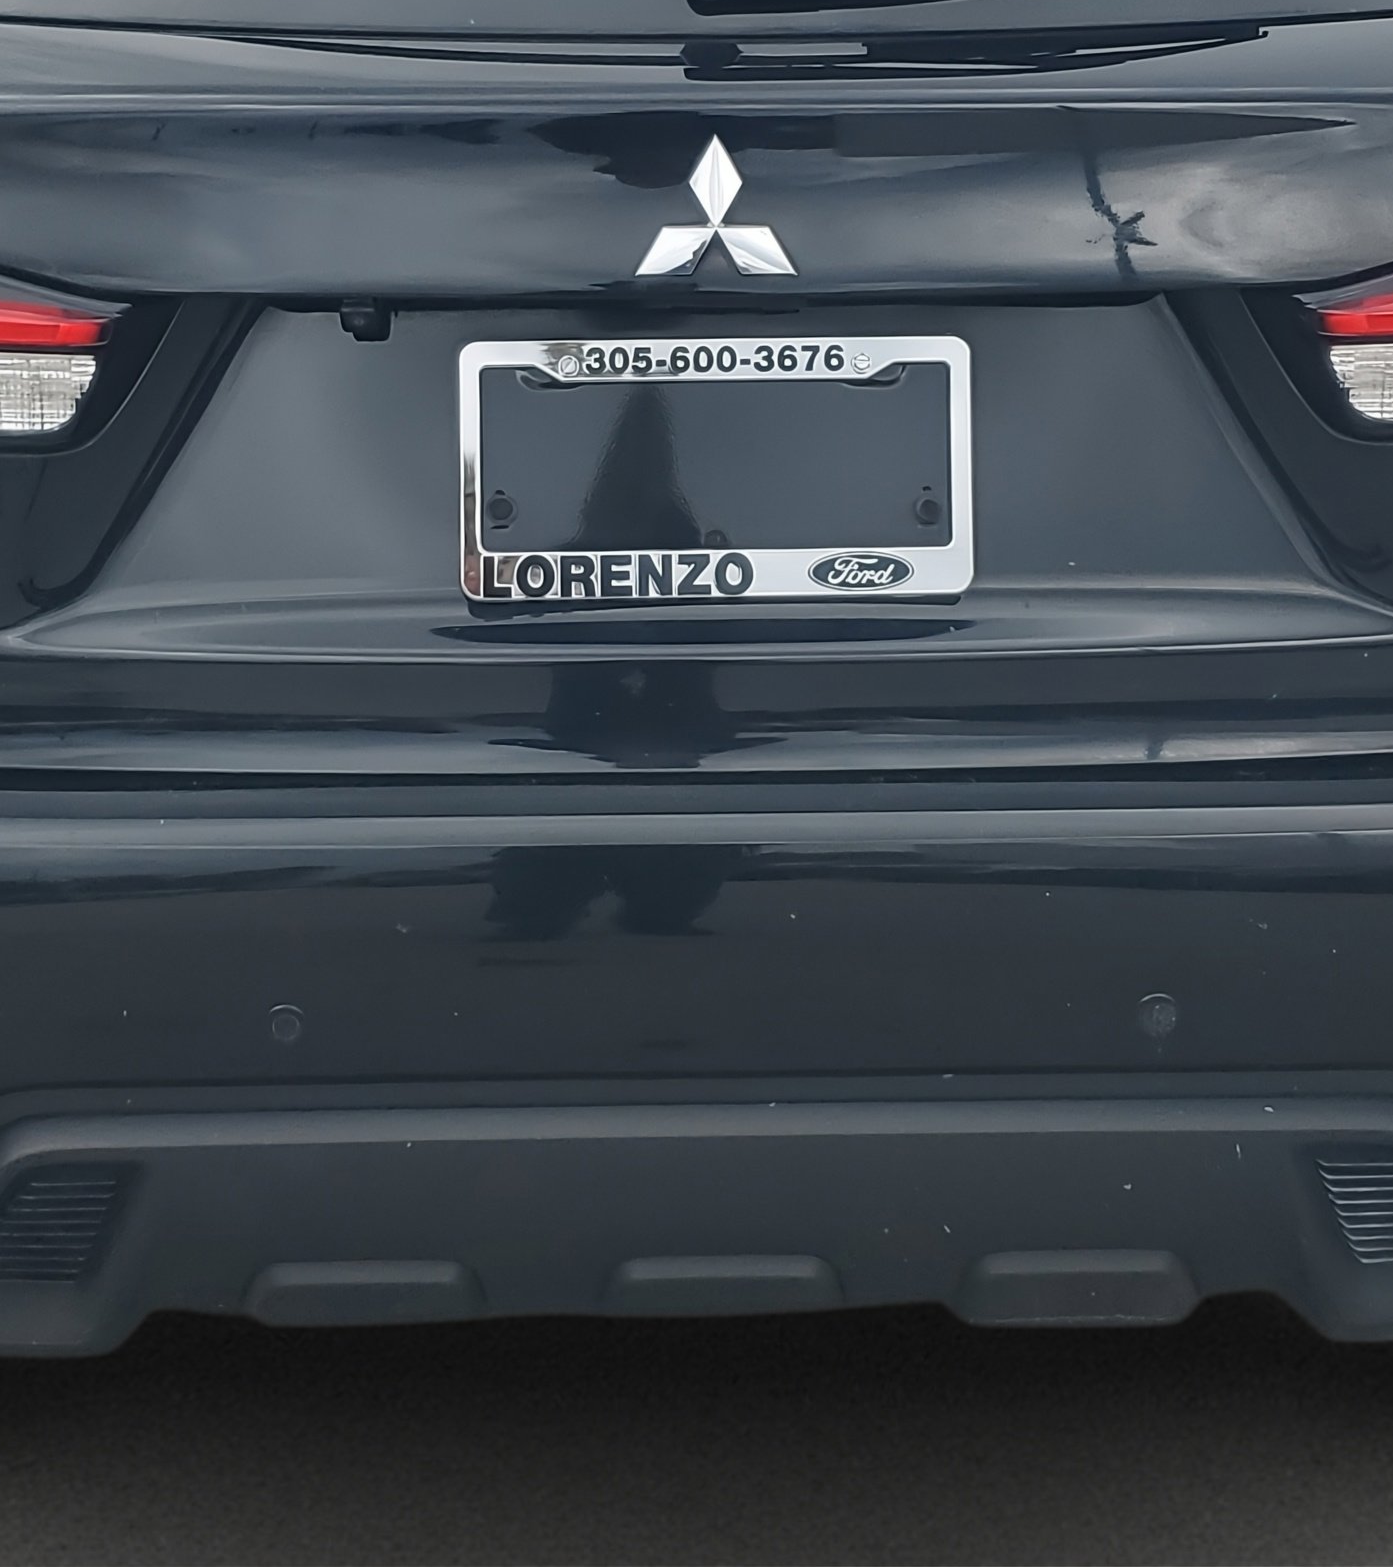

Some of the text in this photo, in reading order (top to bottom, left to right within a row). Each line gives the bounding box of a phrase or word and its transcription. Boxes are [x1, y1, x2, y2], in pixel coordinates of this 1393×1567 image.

[585, 344, 845, 374] 305-600-3676
[481, 552, 895, 598] LORENZO Ford
